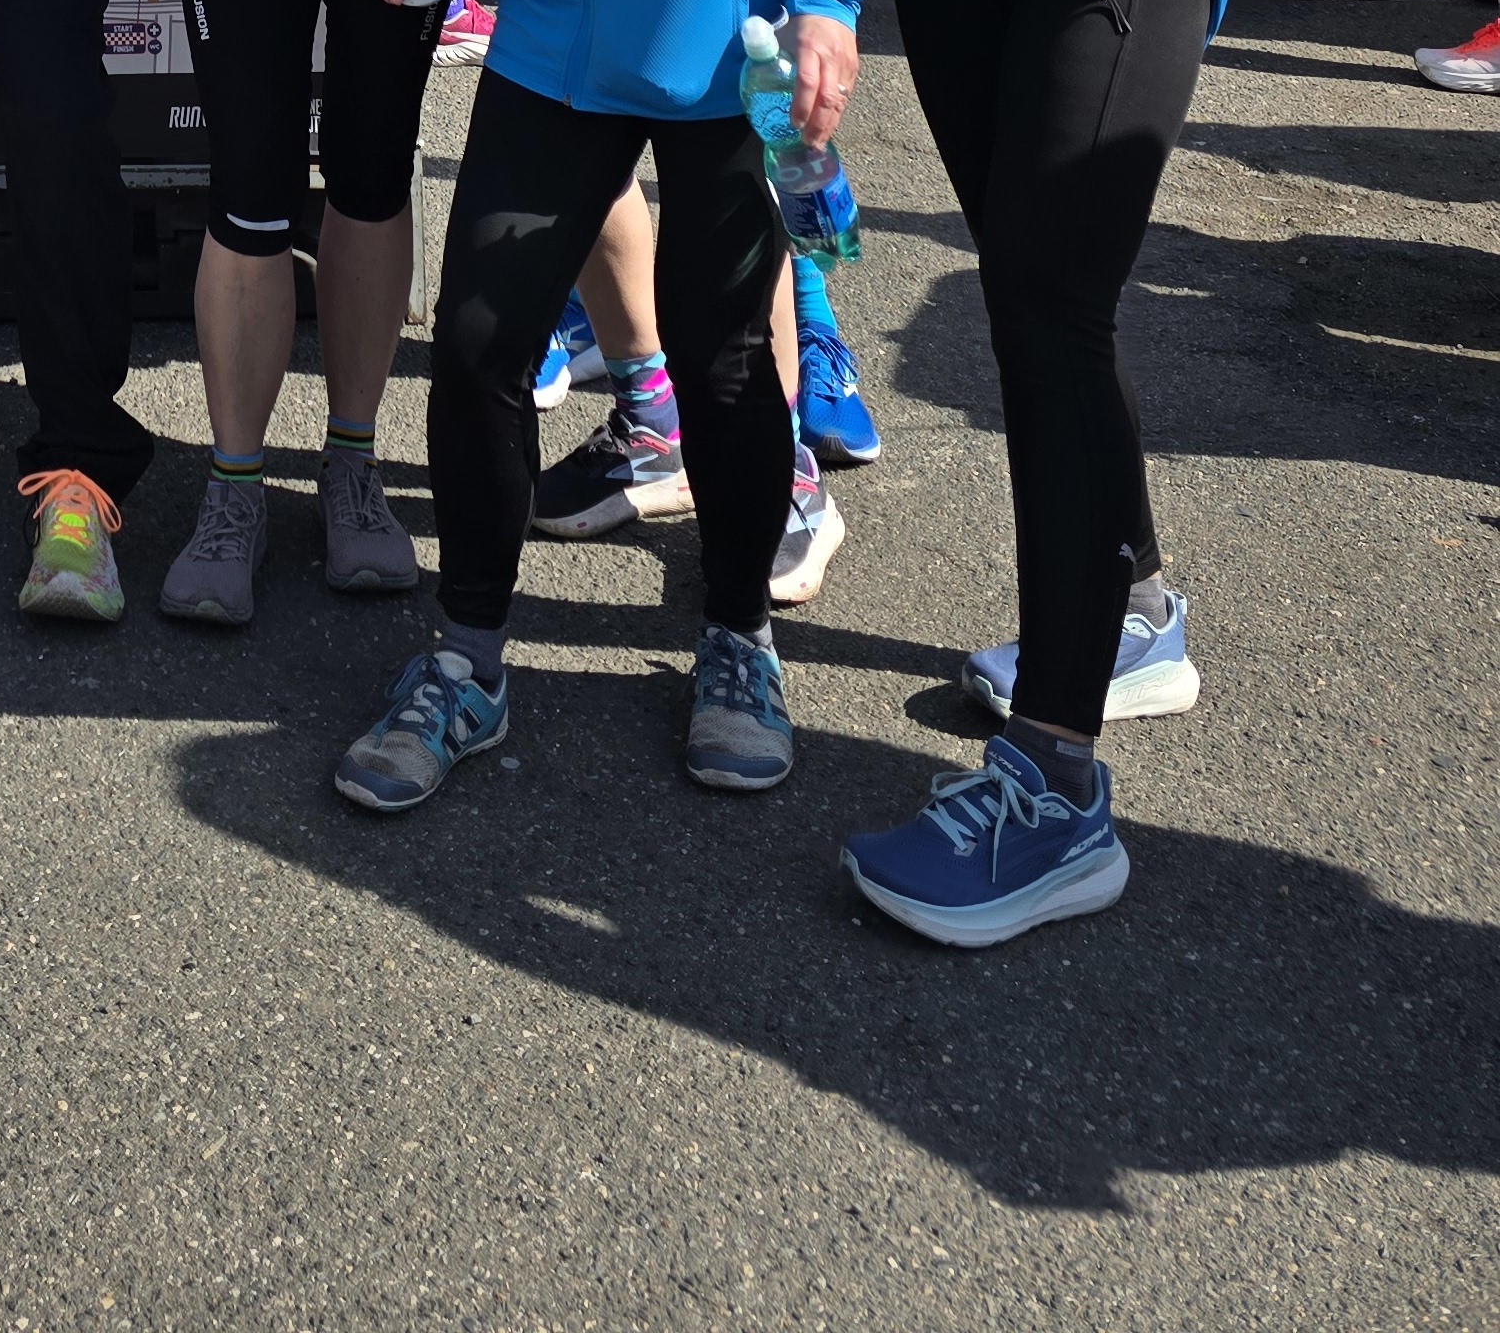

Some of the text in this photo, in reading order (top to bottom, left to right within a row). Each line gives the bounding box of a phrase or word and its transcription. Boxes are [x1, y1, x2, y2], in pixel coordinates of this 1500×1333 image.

[113, 24, 134, 33] START
[420, 0, 439, 42] FUSIO
[168, 105, 206, 129] RUN
